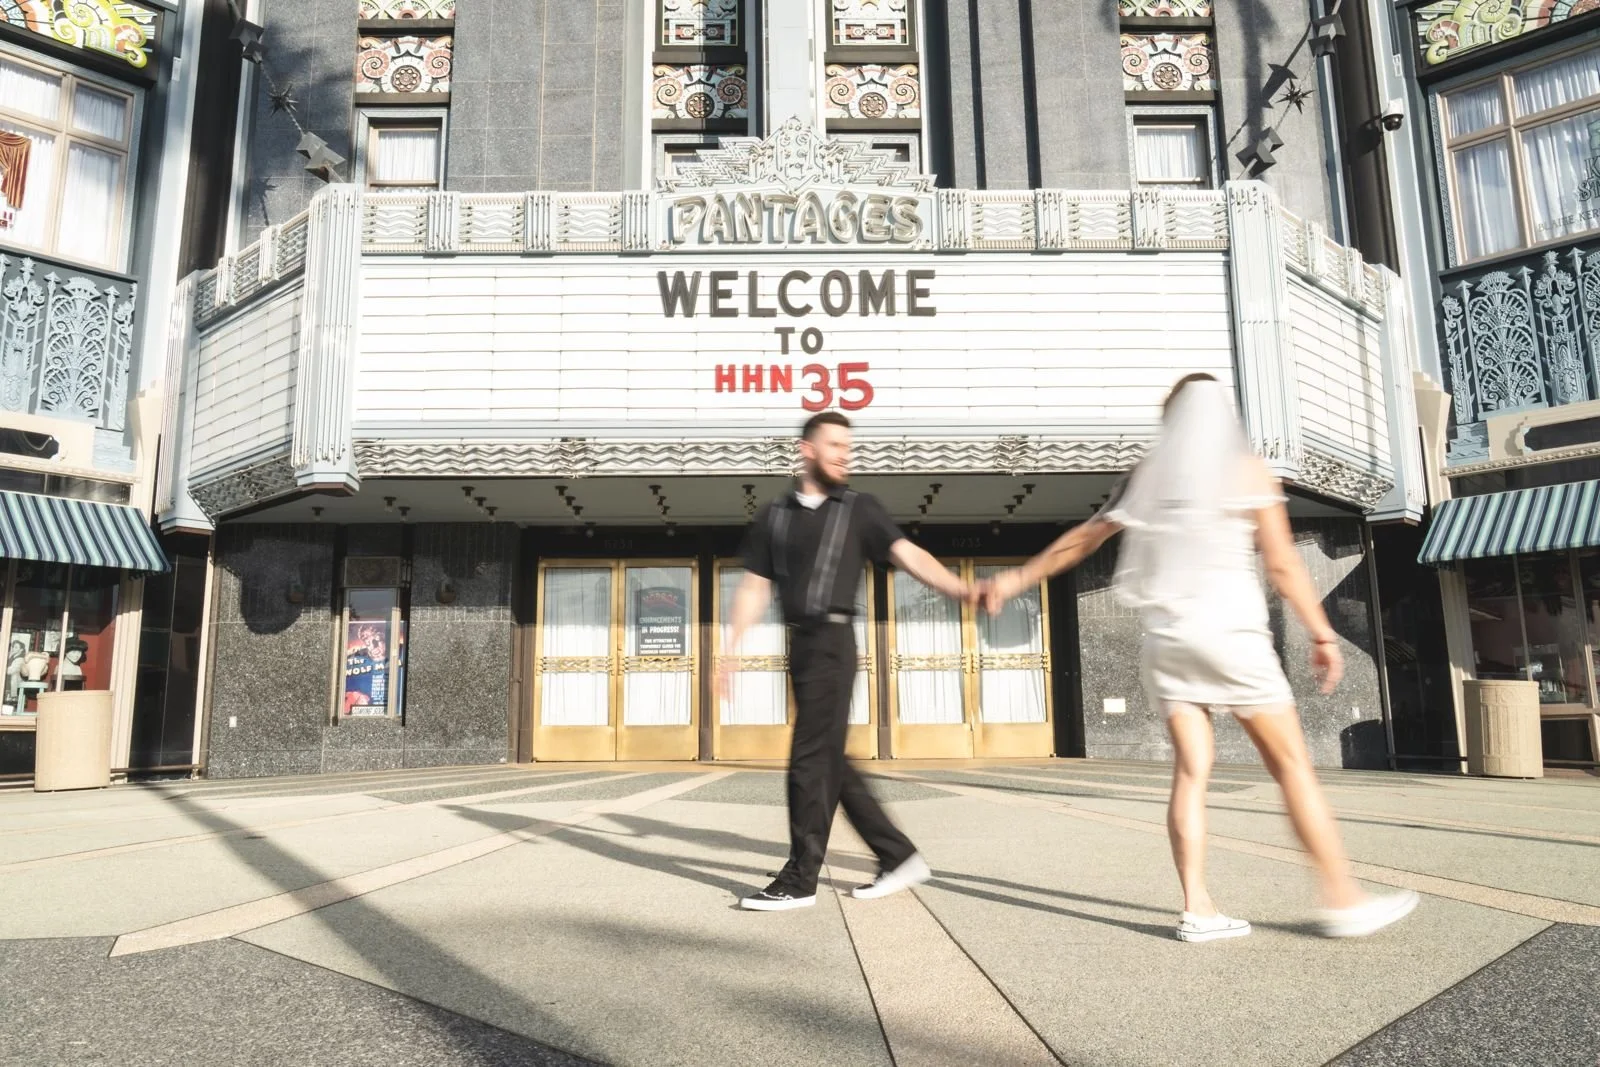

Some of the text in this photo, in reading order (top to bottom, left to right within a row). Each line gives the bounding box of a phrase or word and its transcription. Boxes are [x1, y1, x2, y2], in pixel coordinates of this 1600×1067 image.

[671, 190, 924, 244] PANTAGES
[657, 269, 937, 318] WELCOME
[774, 326, 824, 355] TO
[714, 362, 875, 412] HHN 35
